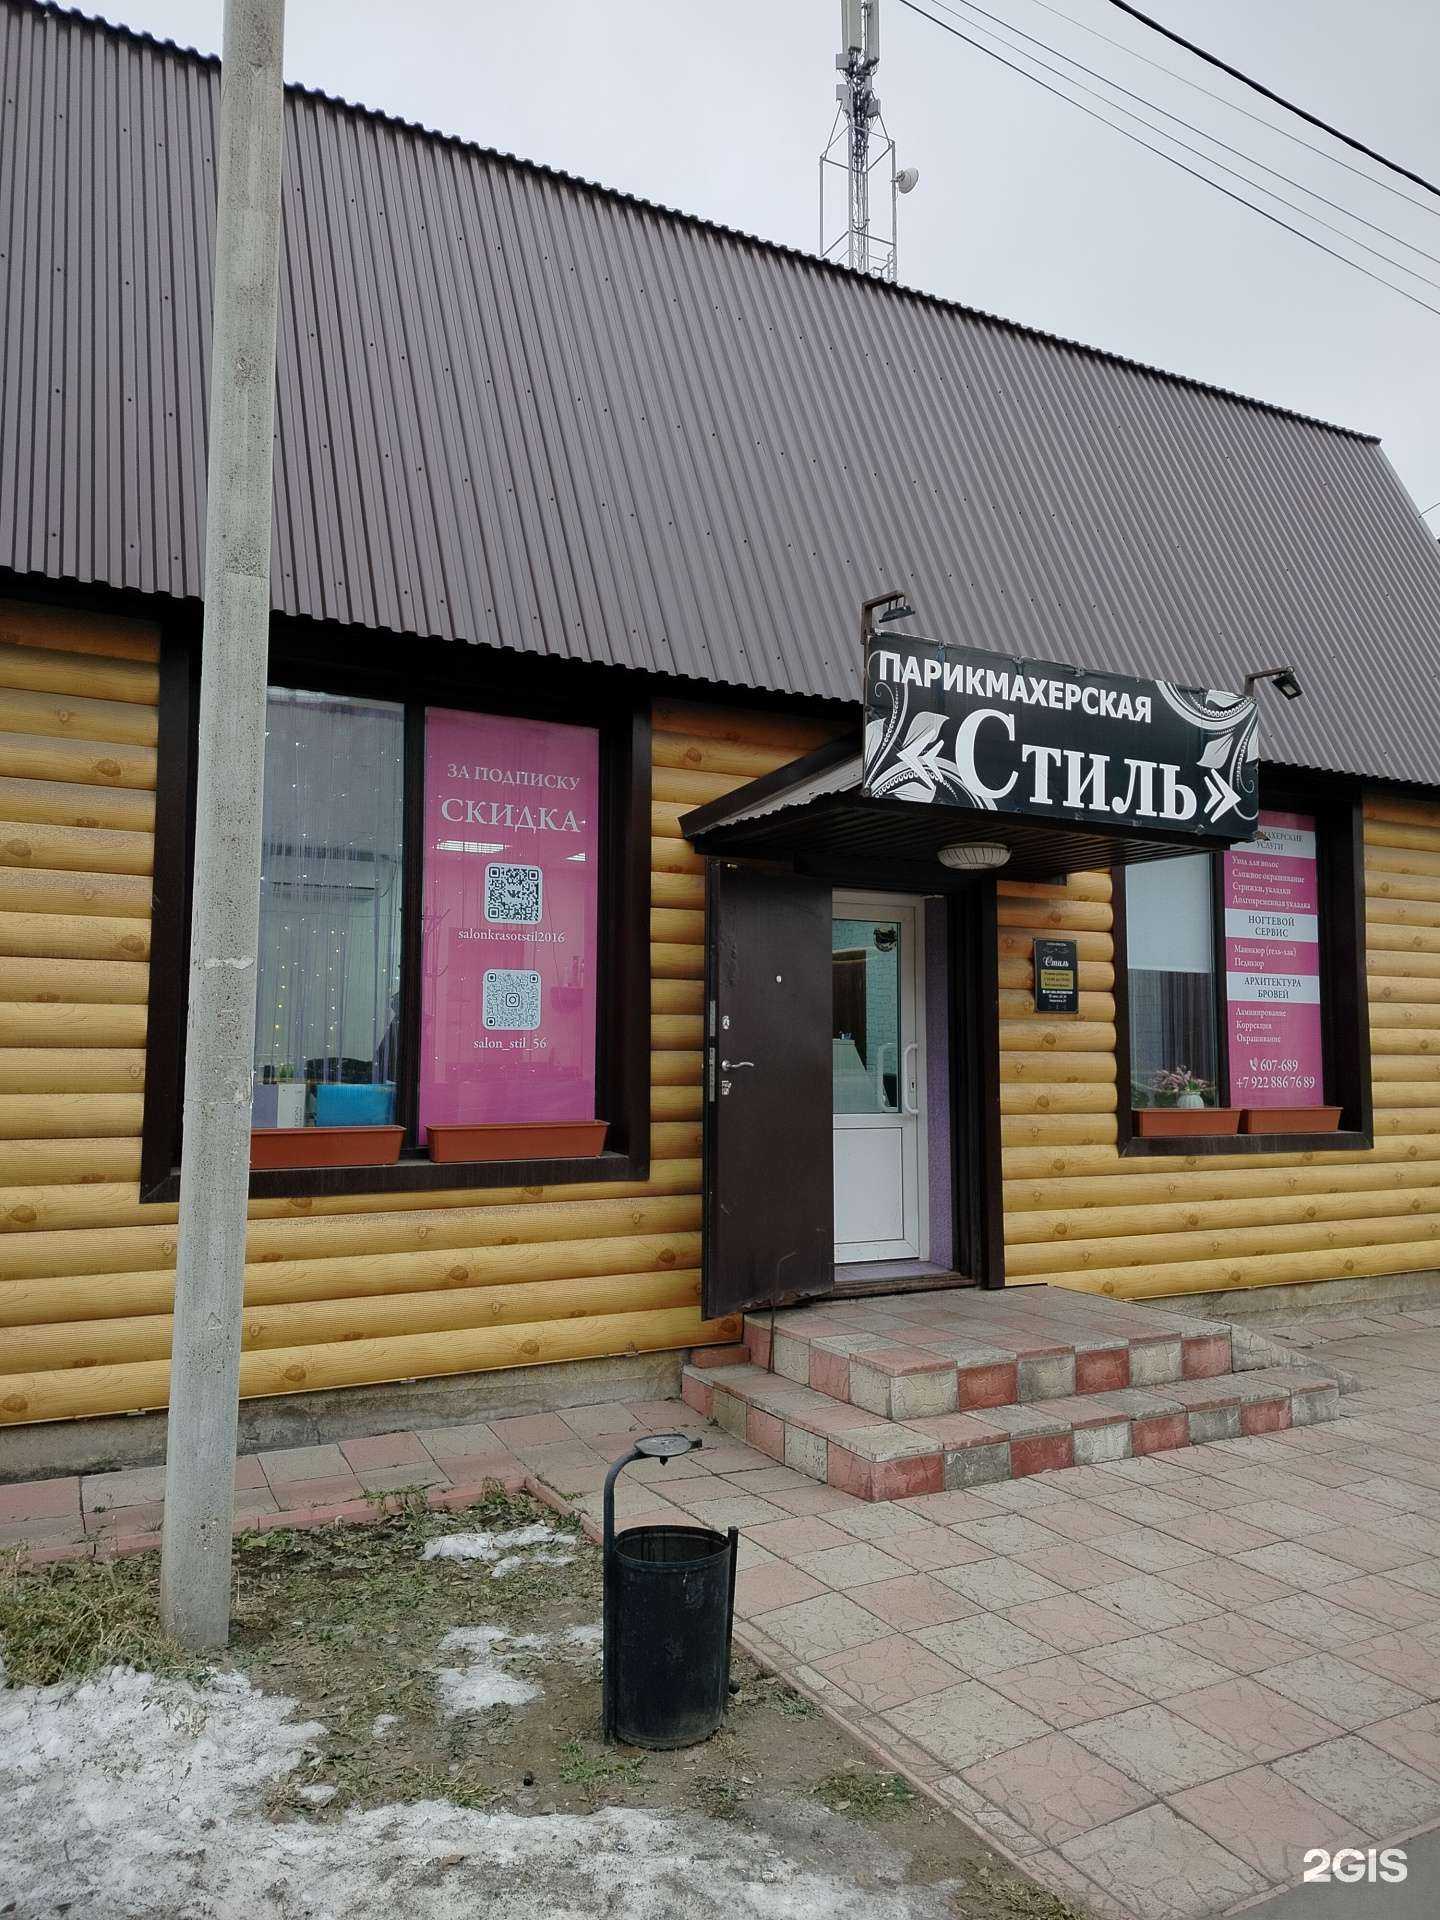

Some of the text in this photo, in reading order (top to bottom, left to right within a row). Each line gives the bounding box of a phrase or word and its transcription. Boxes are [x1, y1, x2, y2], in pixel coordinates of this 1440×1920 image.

[879, 651, 1152, 723] ПАРИКМАХЕРСКАЯ
[447, 763, 580, 791] ЗА ПОДПИСКУ
[441, 798, 581, 833] СКИДКА
[1248, 915, 1295, 927] НОГТЕВОЙ
[458, 928, 566, 944] salonkrasotstil2016
[1255, 927, 1289, 938] СЕРВИС
[1234, 944, 1265, 957] Маникюр
[1234, 957, 1265, 970] Педикюр
[1244, 976, 1302, 988] АРХИТЕКТУРА
[1257, 989, 1290, 999] БРОВЕЙ
[1236, 1007, 1287, 1018] Ламинирование
[1236, 1020, 1272, 1031] Коррекция
[473, 1036, 547, 1051] salon_stil_56
[1236, 1034, 1281, 1044] Окрашивание
[1260, 1059, 1298, 1073] 607-689
[1236, 1076, 1315, 1089] +7 922 886 76 89
